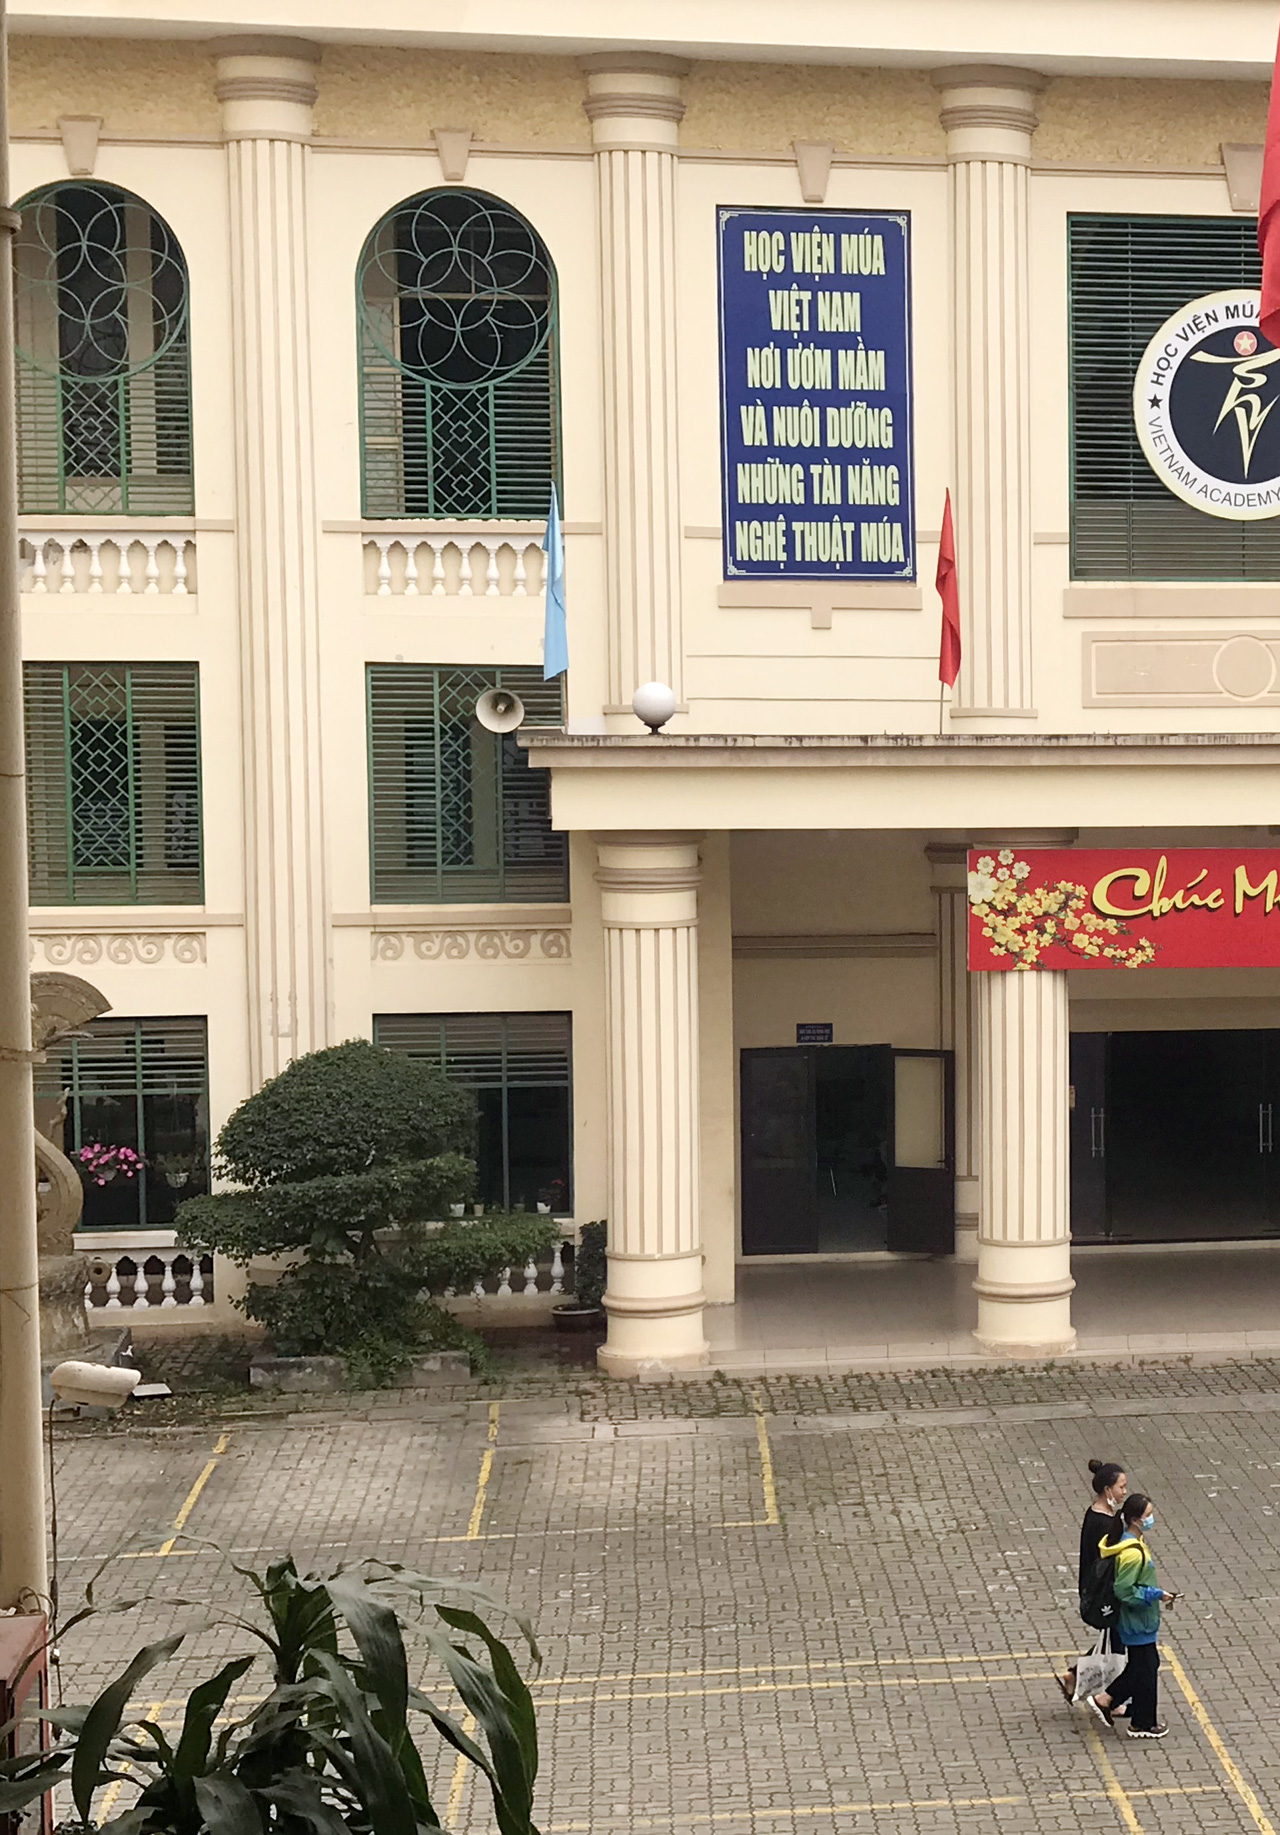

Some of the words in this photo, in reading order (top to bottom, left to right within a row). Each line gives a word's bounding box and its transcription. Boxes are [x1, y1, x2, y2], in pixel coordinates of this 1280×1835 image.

[743, 230, 785, 280] HỌC
[791, 225, 835, 281] VIỆN
[841, 228, 886, 275] MÚA
[768, 283, 812, 339] VIỆT
[818, 291, 861, 332] NAM
[747, 342, 781, 389] NƠI
[787, 342, 832, 390] ƯƠM
[838, 336, 885, 390] MẦM
[1150, 343, 1179, 386] HỌC
[1175, 313, 1219, 342] VIỆN
[740, 399, 768, 446] VÀ
[772, 399, 820, 448] NUÔI
[826, 401, 893, 449] DƯỠNG
[737, 457, 805, 504] NHỮNG
[810, 458, 842, 505] TÀI
[848, 458, 900, 506] NĂNG
[1148, 416, 1198, 490] VIETNAM
[1196, 486, 1280, 507] ACADEMY
[735, 514, 787, 569] NGHỆ
[792, 514, 855, 569] THUẬT
[860, 516, 905, 563] MÚA
[1092, 855, 1225, 917] Chúc
